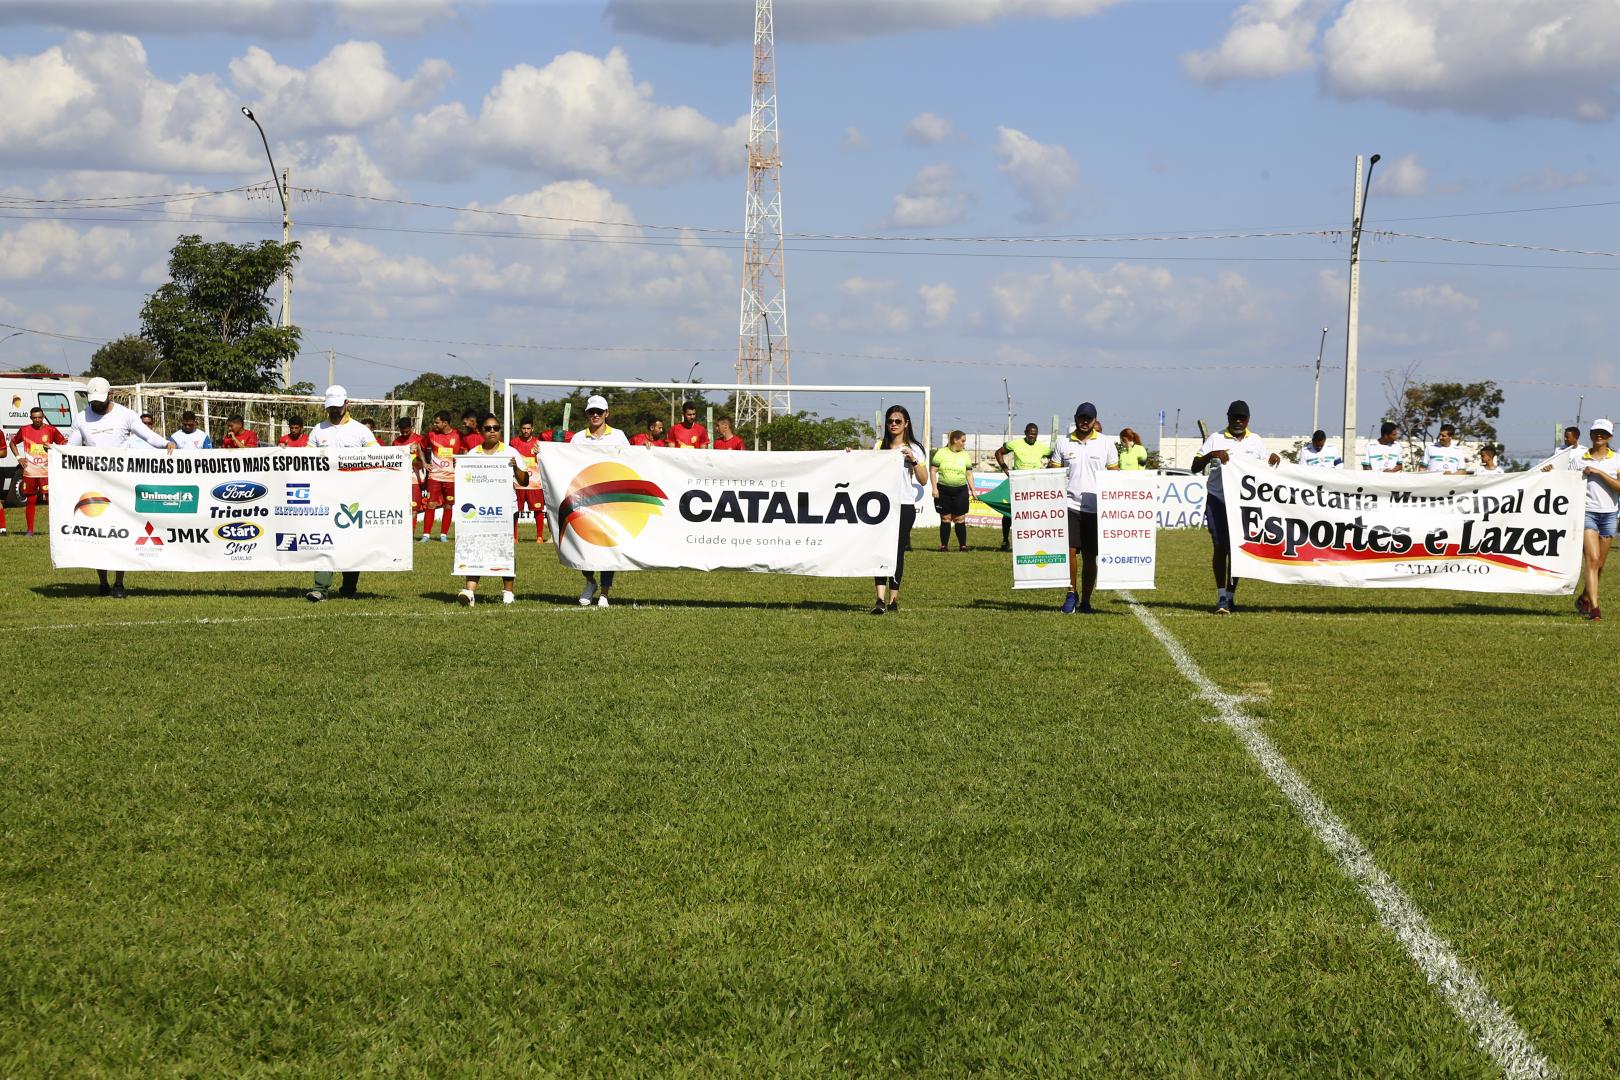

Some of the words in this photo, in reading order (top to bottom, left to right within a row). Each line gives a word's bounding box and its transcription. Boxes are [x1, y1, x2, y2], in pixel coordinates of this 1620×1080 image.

[367, 453, 395, 461] Municipal
[61, 454, 125, 473] EMPRESAS
[126, 457, 174, 474] AMIGAS
[176, 458, 192, 474] DO
[194, 457, 241, 474] PROJETO
[242, 457, 271, 473] MAIS
[272, 456, 330, 472] ESPORTES
[338, 460, 373, 469] Esportes
[381, 459, 403, 468] Lazer
[687, 478, 765, 487] PREFEITURA
[771, 480, 786, 488] DE
[141, 491, 180, 500] Unimed
[222, 484, 255, 499] Ford
[1014, 490, 1064, 501] EMPRESA
[1101, 491, 1153, 500] EMPRESA
[1239, 474, 1378, 511] Secretaria
[1390, 488, 1524, 522] Municipal
[1533, 488, 1569, 516] de
[678, 482, 891, 526] CATALÃO
[210, 506, 269, 519] Triauto
[365, 510, 403, 519] CLEAN
[478, 506, 503, 516] SAE
[1014, 510, 1048, 520] AMIGA
[1050, 509, 1065, 519] DO
[1101, 510, 1135, 519] AMIGA
[1137, 510, 1153, 519] DO
[61, 525, 130, 539] CATALÃO
[166, 528, 211, 544] JMK
[222, 525, 256, 538] Start
[1016, 529, 1064, 539] ESPORTE
[1103, 529, 1151, 539] ESPORTE
[1240, 505, 1413, 557] Esportes
[1424, 527, 1449, 555] e
[1458, 519, 1567, 557] Lazer
[298, 533, 333, 545] ASA
[686, 534, 727, 545] Cidade
[730, 537, 756, 547] que
[756, 537, 791, 546] sonha
[795, 538, 802, 546] e
[805, 536, 823, 546] faz
[224, 541, 257, 556] Shop
[1114, 556, 1152, 564] OBJETIVO
[1394, 562, 1490, 575] CATALÃO-GO
